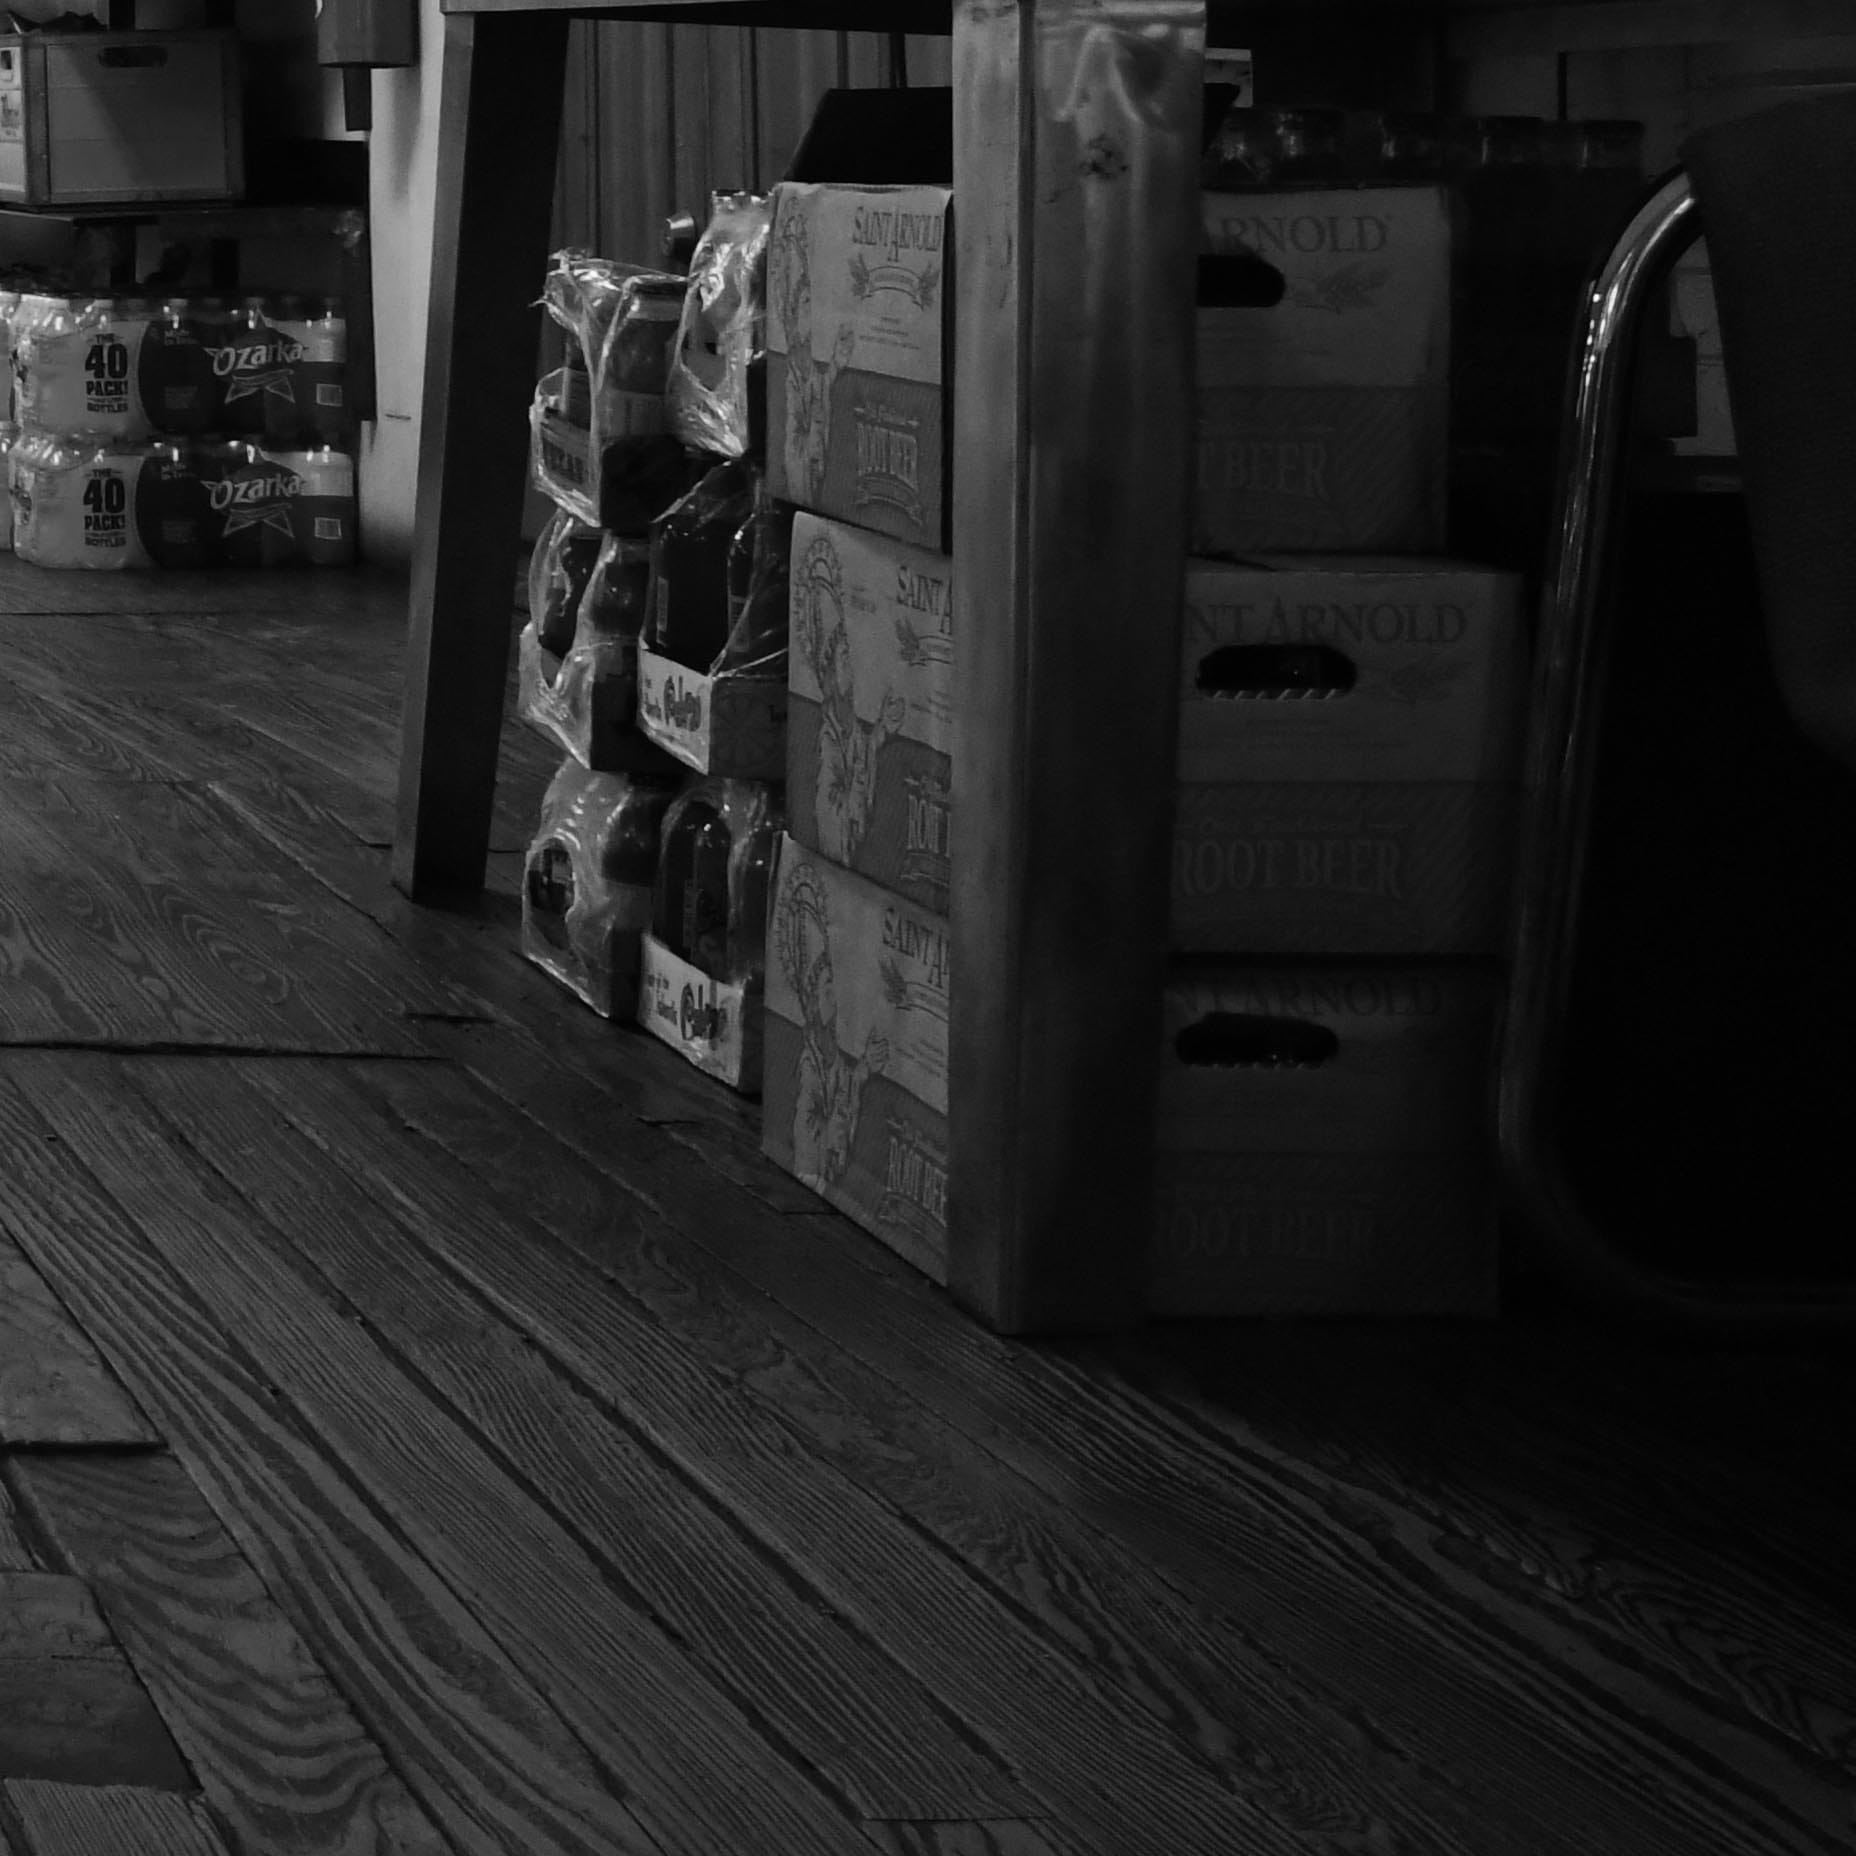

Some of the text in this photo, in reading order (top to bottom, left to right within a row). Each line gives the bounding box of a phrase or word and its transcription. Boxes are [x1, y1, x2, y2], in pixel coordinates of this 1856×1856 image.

[85, 343, 129, 379] 40
[211, 340, 304, 376] Ozarka
[83, 478, 127, 513] 40
[209, 472, 302, 510] Ozarka
